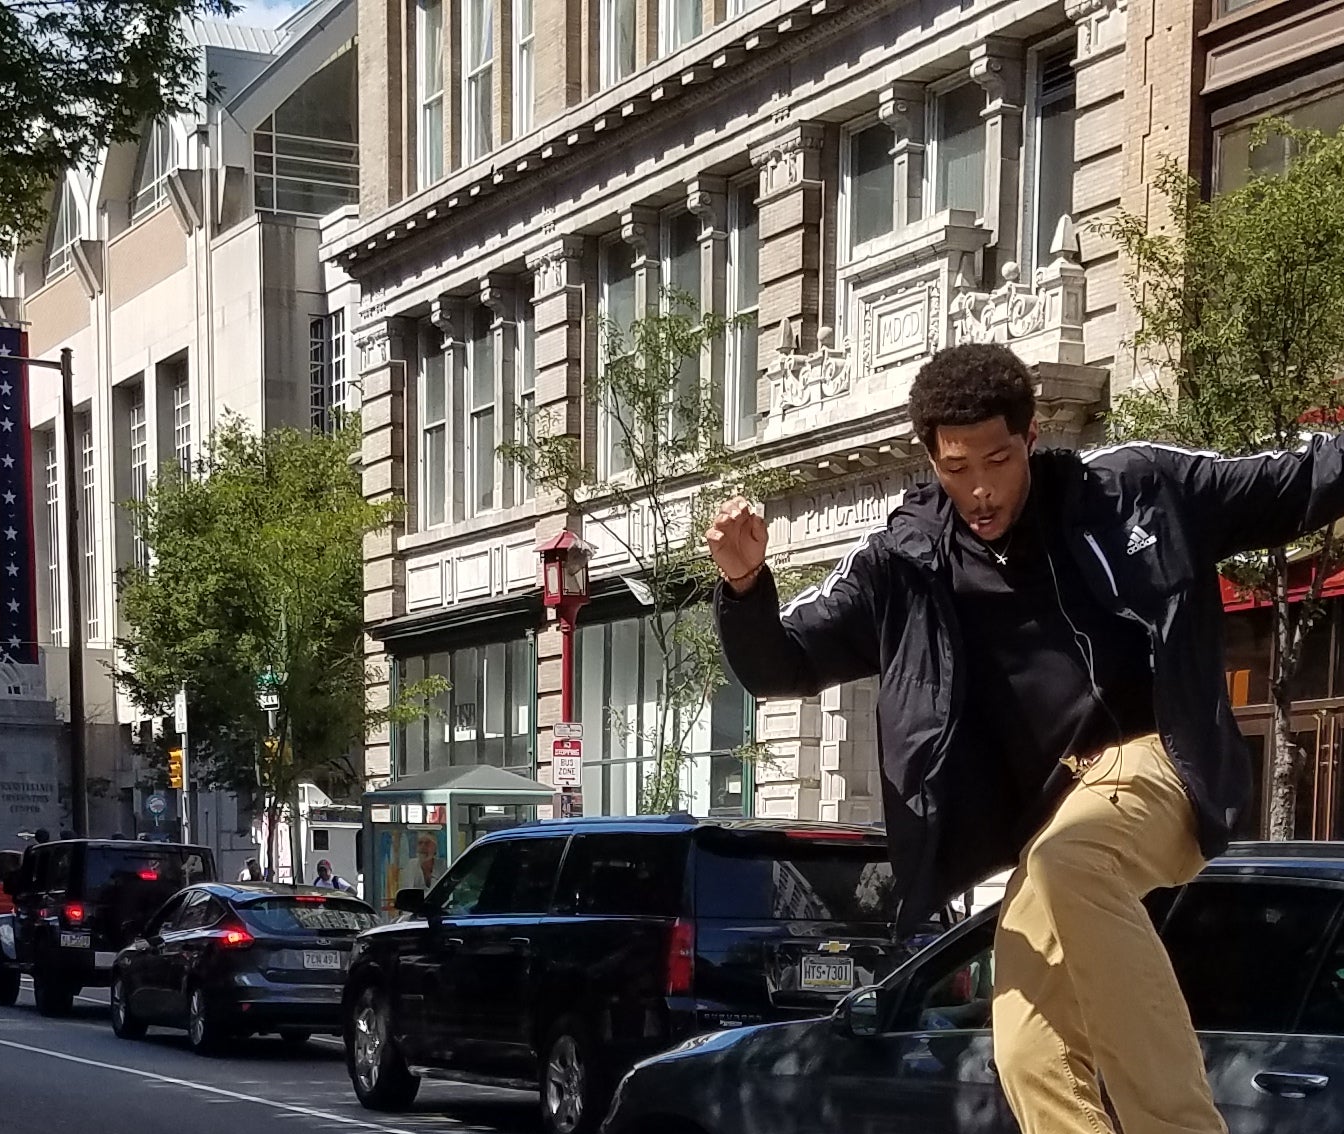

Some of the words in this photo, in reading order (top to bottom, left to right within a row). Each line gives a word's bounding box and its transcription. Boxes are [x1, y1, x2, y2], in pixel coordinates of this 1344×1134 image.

[1126, 535, 1158, 556] adidas
[560, 758, 574, 767] BUS
[558, 767, 576, 775] ZONE
